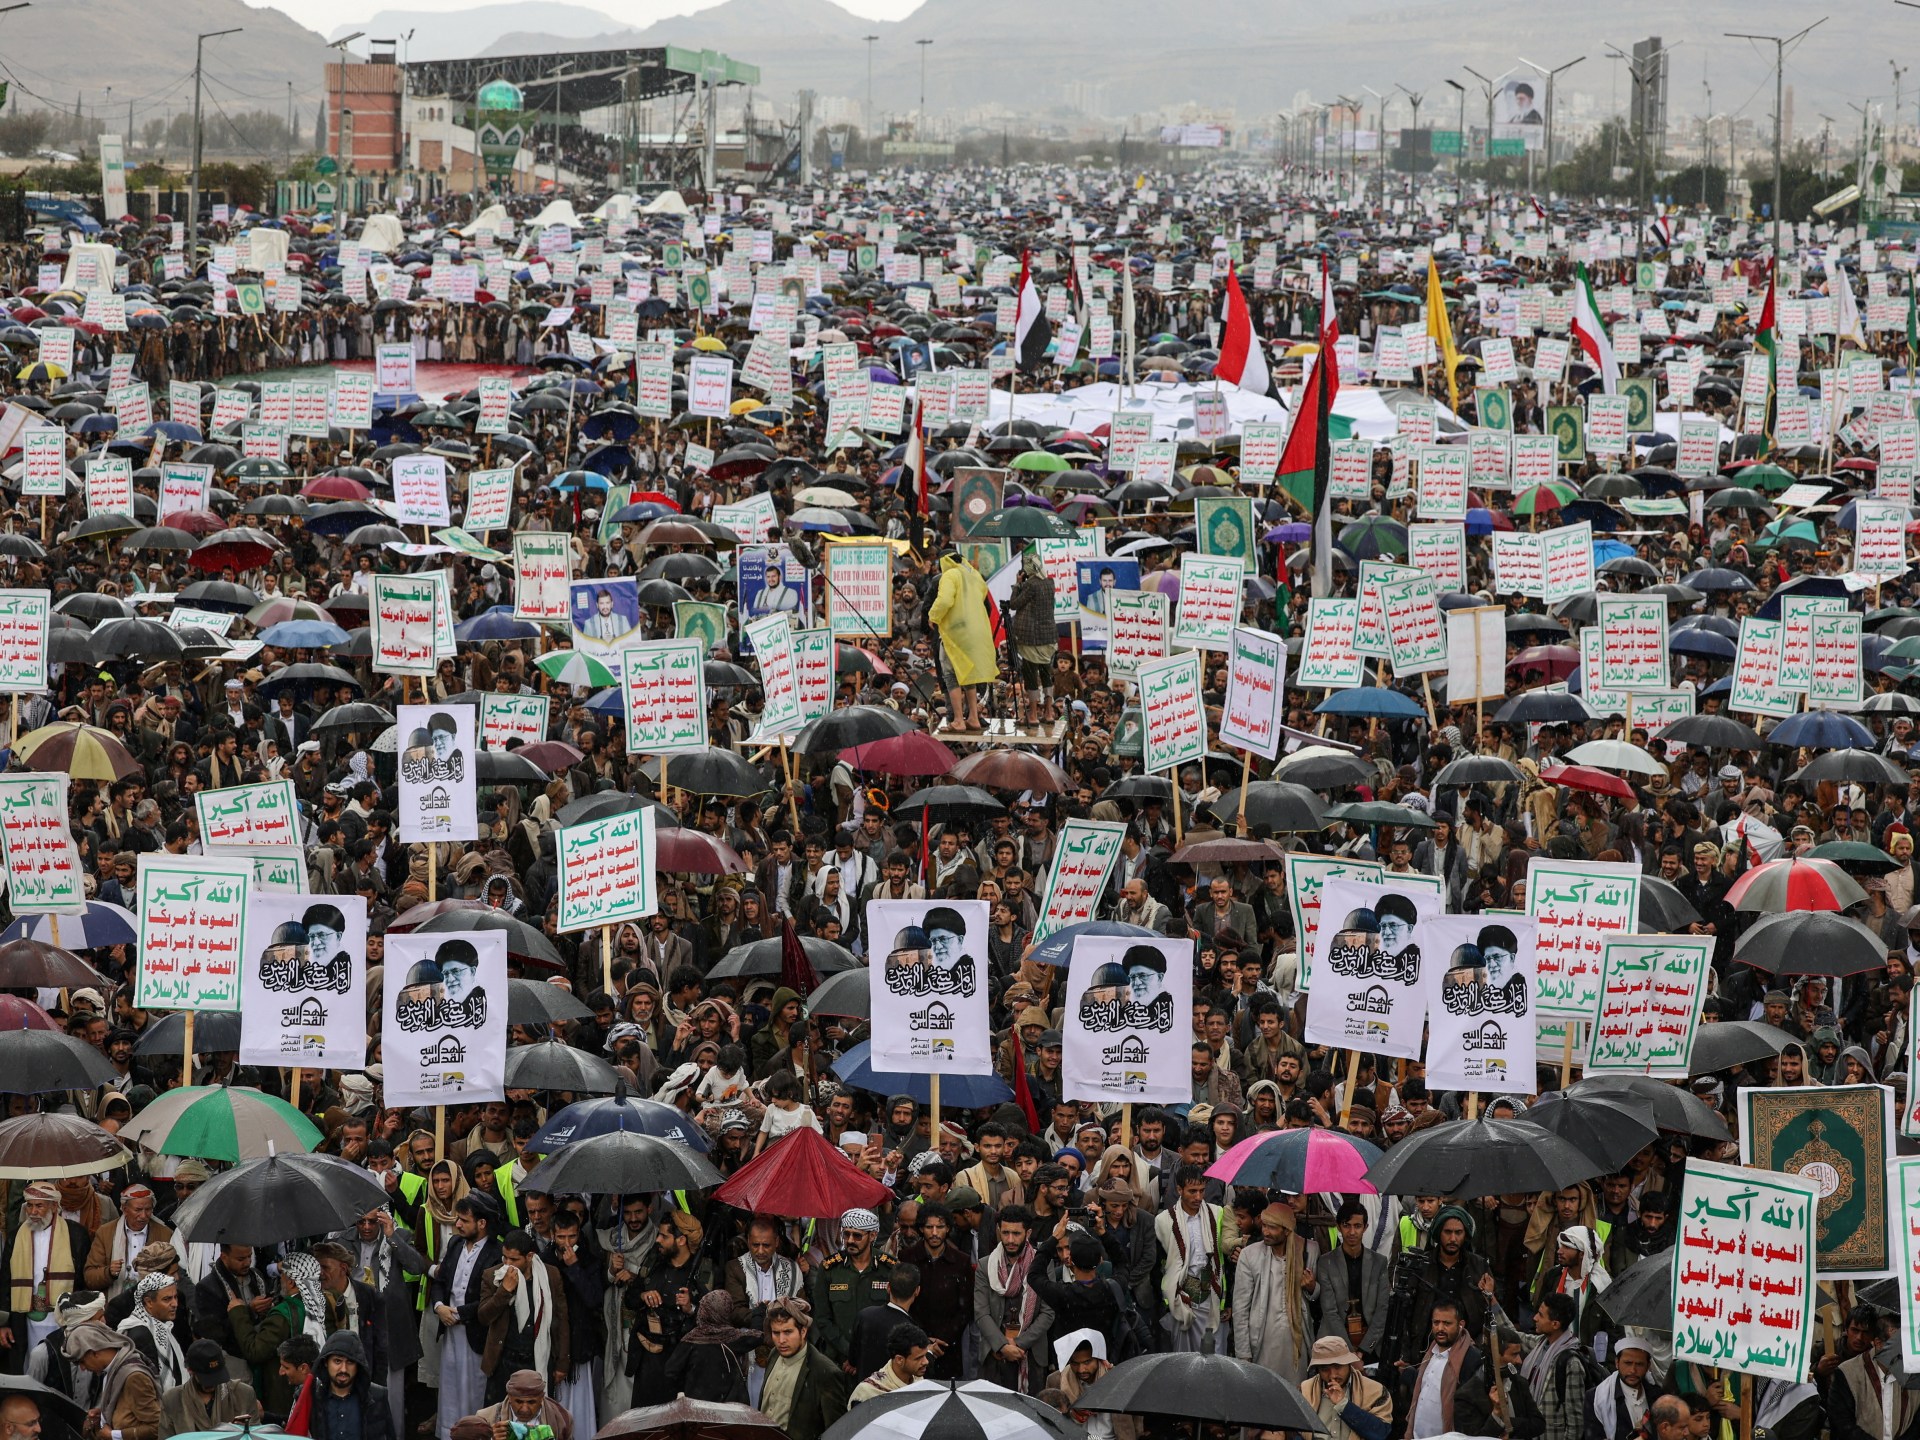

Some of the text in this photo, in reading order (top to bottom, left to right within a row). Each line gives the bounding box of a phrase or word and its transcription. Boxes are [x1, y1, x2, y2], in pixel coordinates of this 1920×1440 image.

[520, 538, 563, 559] قاطعوا
[833, 550, 886, 564] ALLAH IS THE GREATEST
[544, 564, 567, 581] البضائع
[833, 570, 885, 581] DEATH TO AMERICA
[379, 584, 431, 601] قاطعوا
[853, 585, 859, 595] TO
[861, 585, 880, 595] ISRAEL
[862, 601, 871, 611] THE
[872, 601, 884, 611] JEWS
[1602, 604, 1637, 623] أكبر
[406, 610, 431, 624] البضائع
[833, 616, 858, 629] VICTORY
[868, 616, 885, 628] ISLAM
[401, 628, 404, 639] و
[1605, 625, 1660, 636] الموت لأمريكا
[1637, 640, 1660, 650] الموت
[630, 652, 668, 676] أكبر
[1605, 654, 1661, 665] اللعنة على اليهود
[630, 674, 696, 690] الموت لأمريكا
[1606, 667, 1661, 682] النصر للإسلام
[632, 692, 696, 708] الموت لإسرائيل
[632, 708, 697, 725] اللعنة على اليهود
[633, 723, 699, 745] النصر للإسلام
[1, 784, 36, 810] أكبر
[208, 790, 252, 821] أكبر
[210, 815, 289, 838] الموت لأمريكا
[566, 822, 608, 852] أكبر
[566, 839, 638, 867] الموت لأمريكا
[566, 856, 638, 886] الموت لإسرائيل
[149, 876, 204, 906] أكبر
[566, 874, 639, 901] اللعنة على اليهود
[1537, 879, 1594, 908] أكبر
[565, 891, 640, 921] النصر للإسلام
[148, 907, 238, 929] الموت لأمريكا
[146, 932, 237, 953] الموت لإسرائيل
[144, 957, 235, 976] اللعنة على اليهود
[1608, 950, 1664, 977] أكبر
[143, 979, 234, 1005] النصر للإسلام
[1606, 976, 1694, 996] الموت لأمريكا
[1603, 999, 1690, 1017] الموت لإسرائيل
[1599, 1018, 1687, 1038] اللعنة على اليهود
[1595, 1040, 1683, 1064] النصر للإسلام
[1684, 1186, 1758, 1224] أكبر
[1683, 1225, 1802, 1263] الموت لأمريكا
[1680, 1260, 1802, 1297] الموت لإسرائيل
[1678, 1296, 1799, 1330] اللعنة على اليهود
[1675, 1325, 1796, 1368] النصر للإسلام
